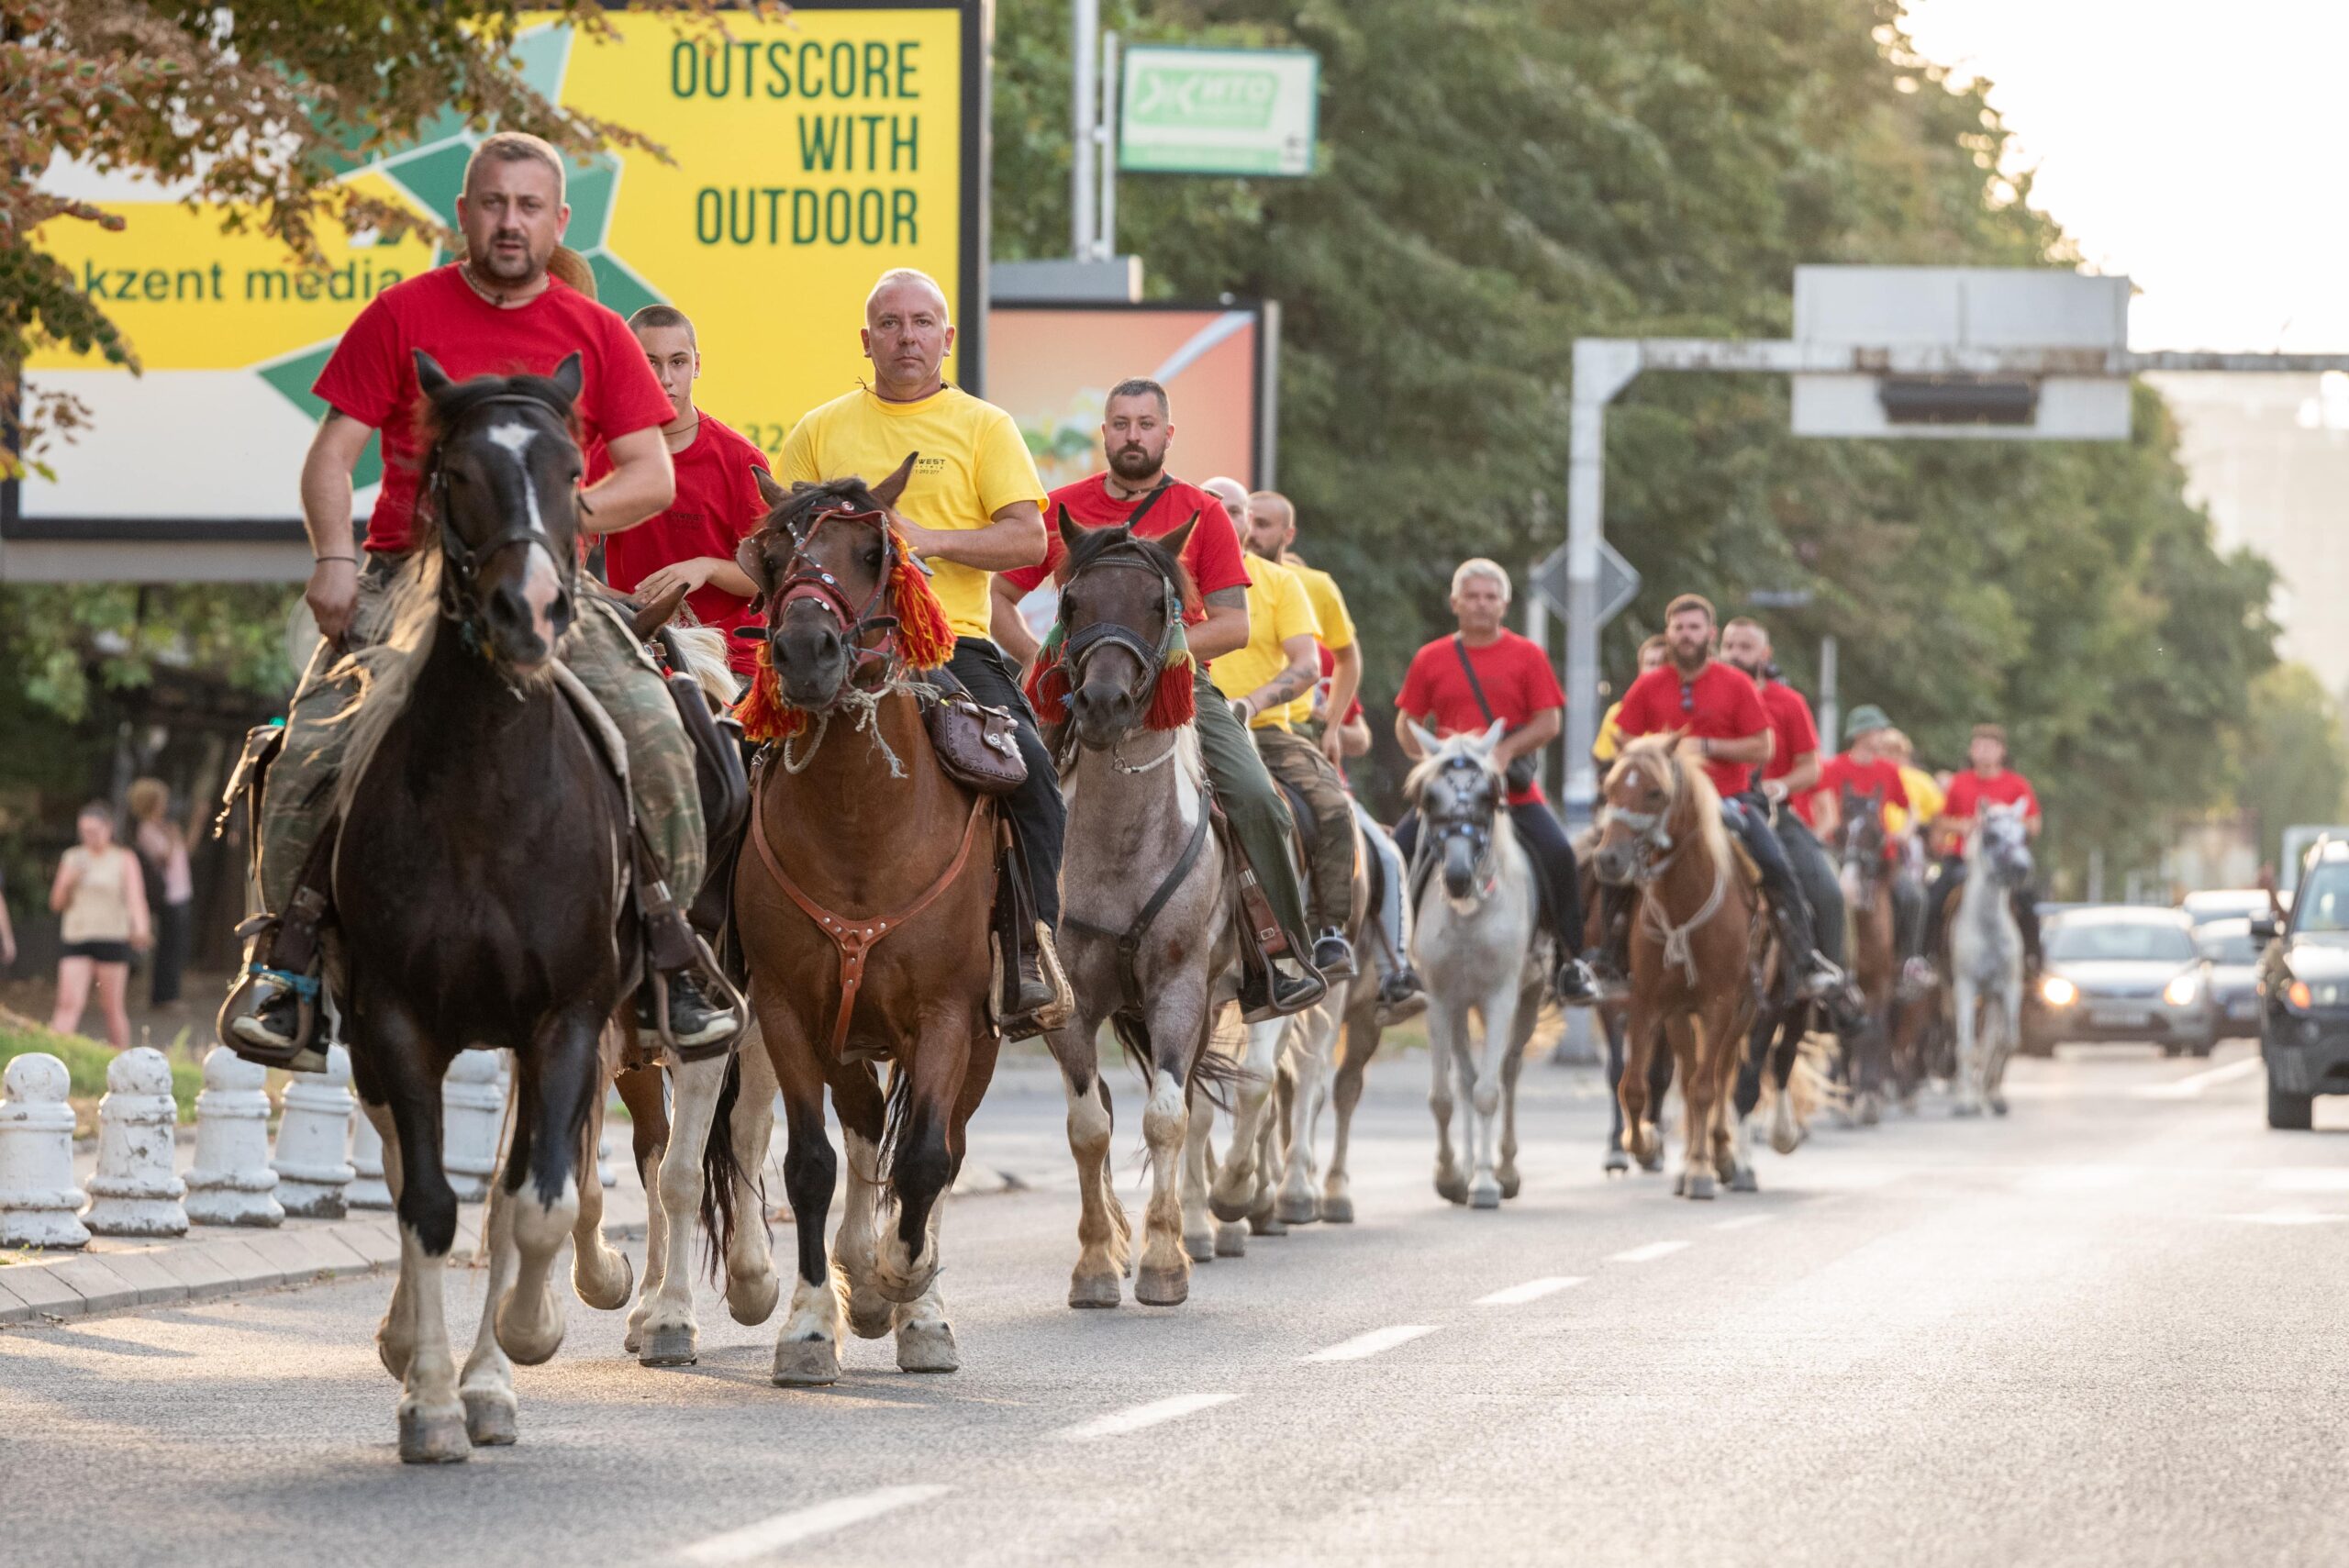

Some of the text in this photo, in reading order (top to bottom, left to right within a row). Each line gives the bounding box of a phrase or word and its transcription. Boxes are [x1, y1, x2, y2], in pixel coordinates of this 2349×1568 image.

[672, 41, 919, 98] OUTSCORE
[797, 115, 918, 172] WITH
[696, 189, 918, 245] OUTDOOR
[84, 259, 223, 301] kzent
